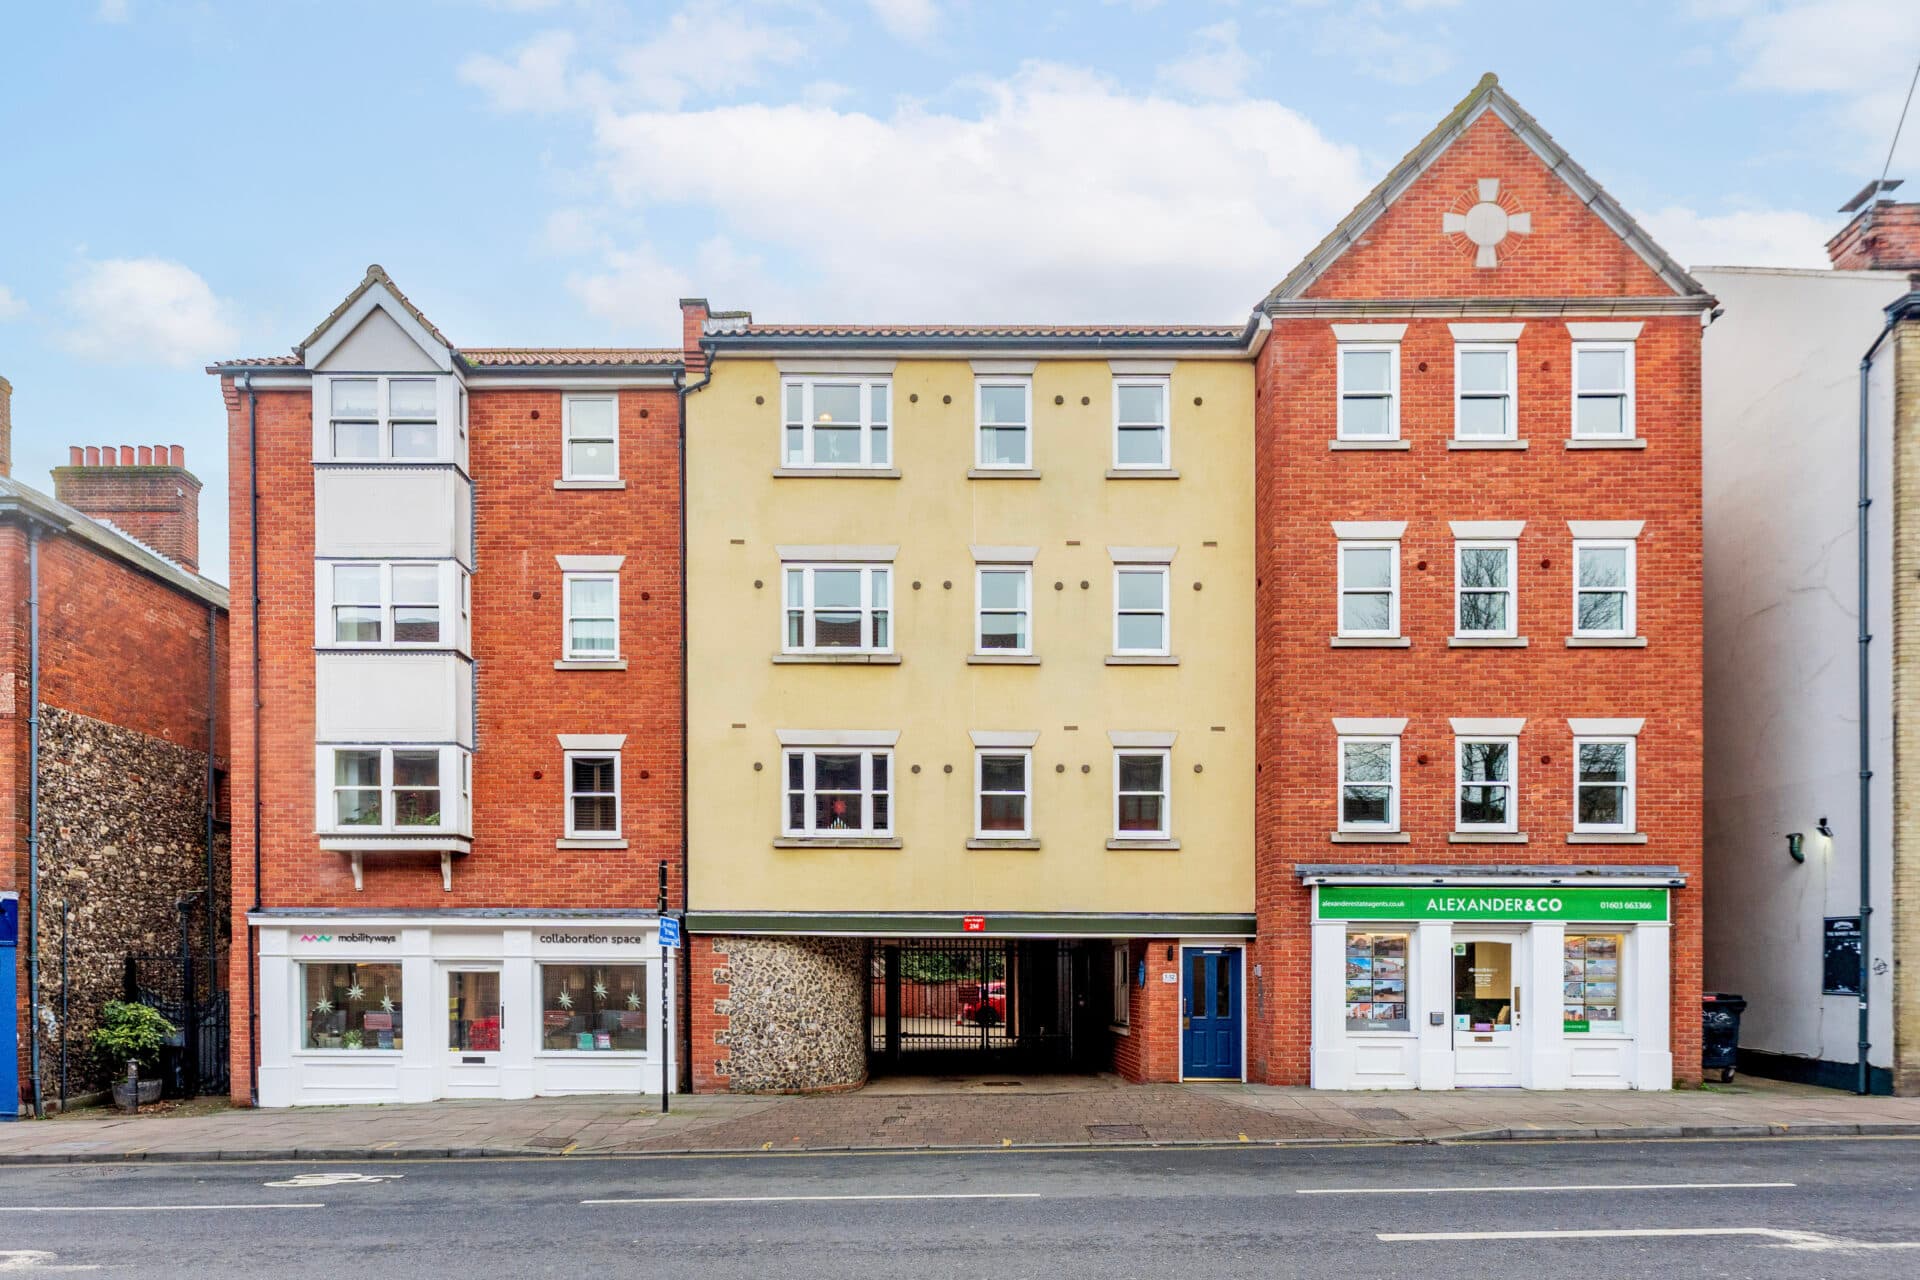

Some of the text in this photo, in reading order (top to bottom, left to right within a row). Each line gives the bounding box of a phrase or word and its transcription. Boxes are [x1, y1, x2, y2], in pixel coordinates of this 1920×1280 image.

[1426, 898, 1563, 912] ALEXANDER&CO
[1600, 901, 1623, 909] 01603
[338, 933, 396, 944] mobilityways
[539, 933, 641, 945] collaboration space
